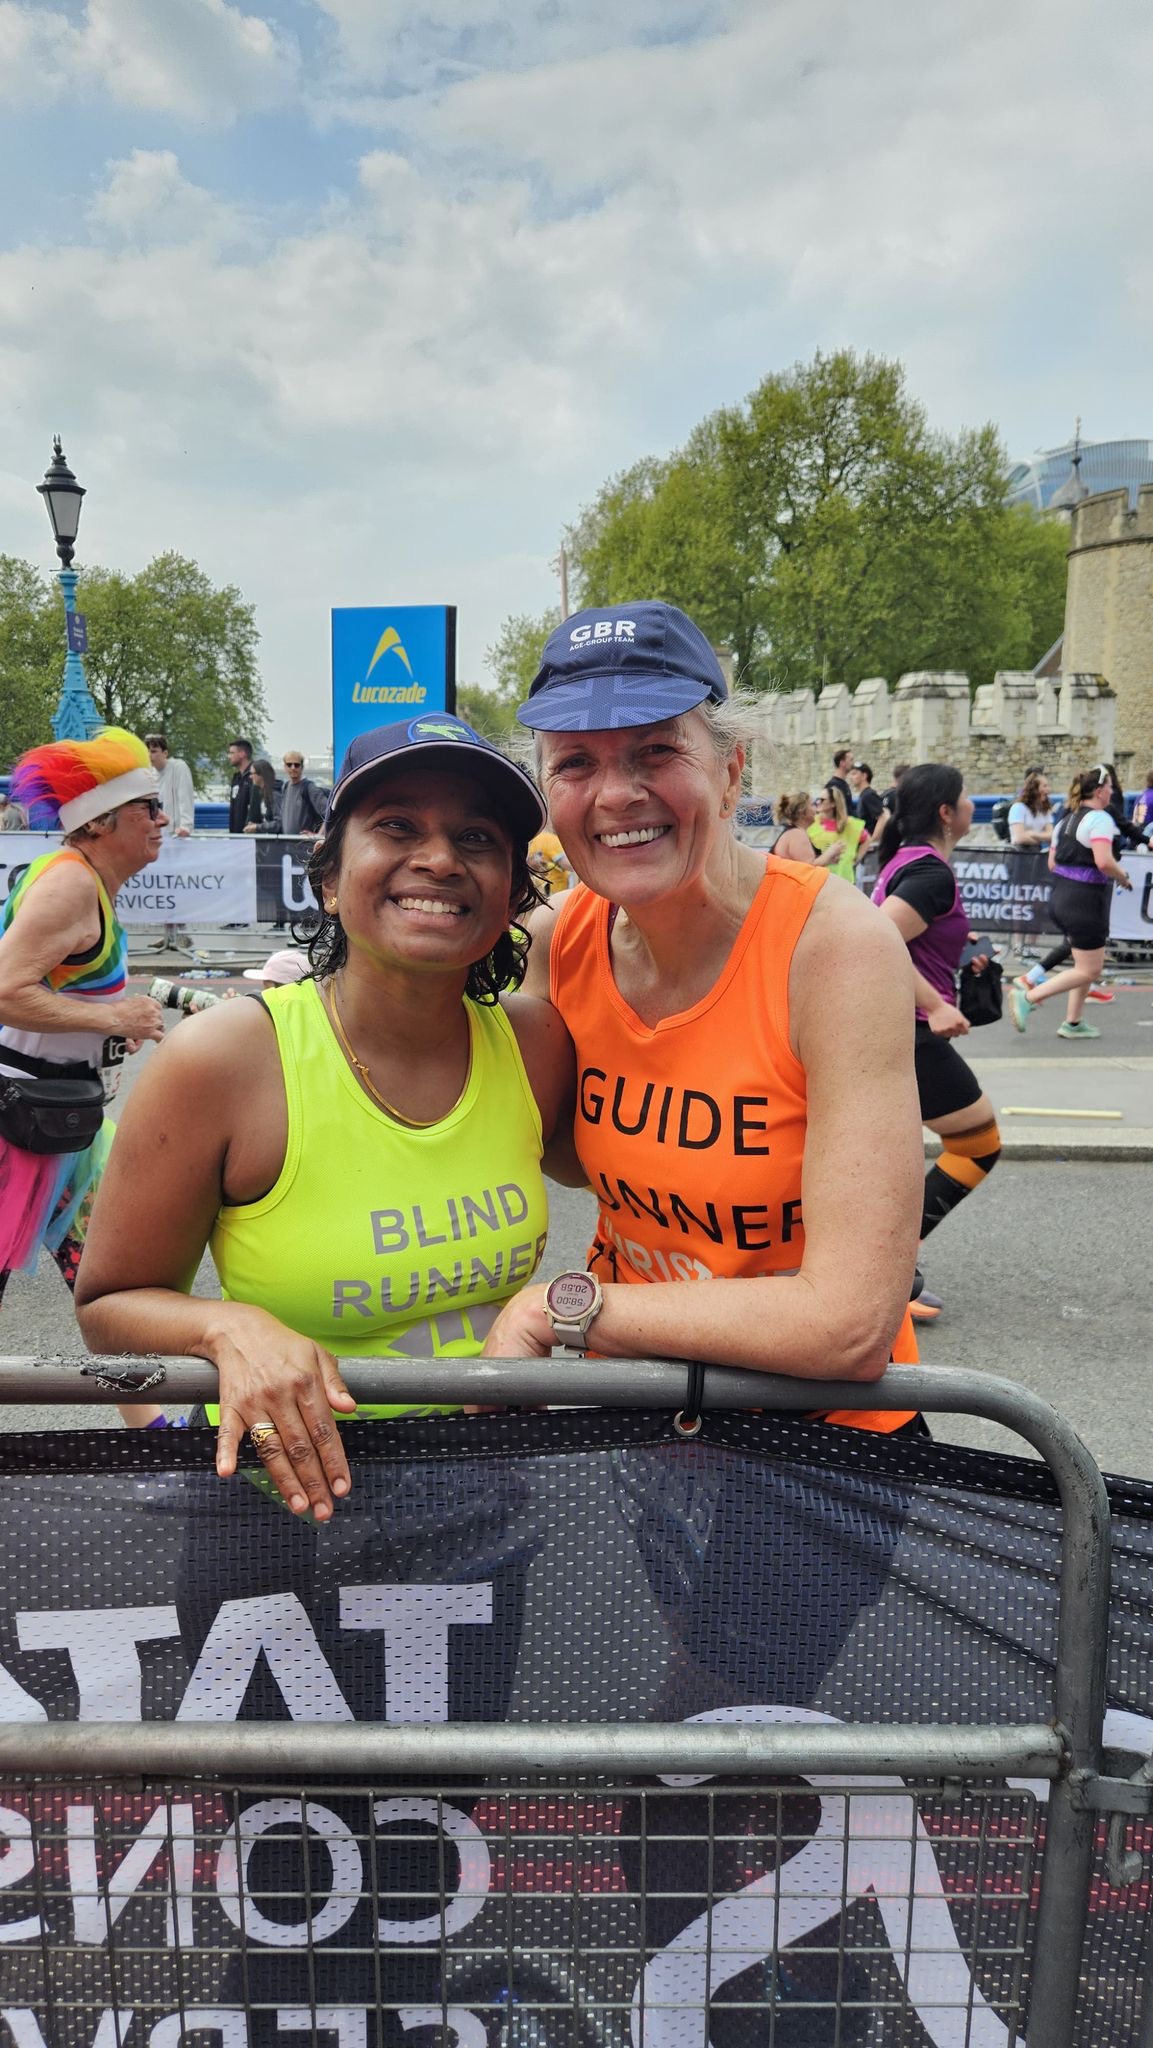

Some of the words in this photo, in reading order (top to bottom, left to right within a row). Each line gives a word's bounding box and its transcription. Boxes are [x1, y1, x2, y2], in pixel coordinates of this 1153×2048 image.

[570, 620, 636, 642] GBR
[569, 637, 613, 651] AGE-GROUP
[352, 681, 427, 703] Lucozade
[953, 861, 1009, 880] TATA
[124, 874, 224, 889] SULTANCY
[956, 881, 1051, 902] ONSULTA
[114, 895, 176, 909] RVICES
[962, 902, 1034, 920] ERVICES
[580, 1067, 770, 1156] GUIDE
[370, 1183, 529, 1255] BLIND
[599, 1172, 803, 1250] UNNE
[332, 1231, 547, 1318] RUNNER
